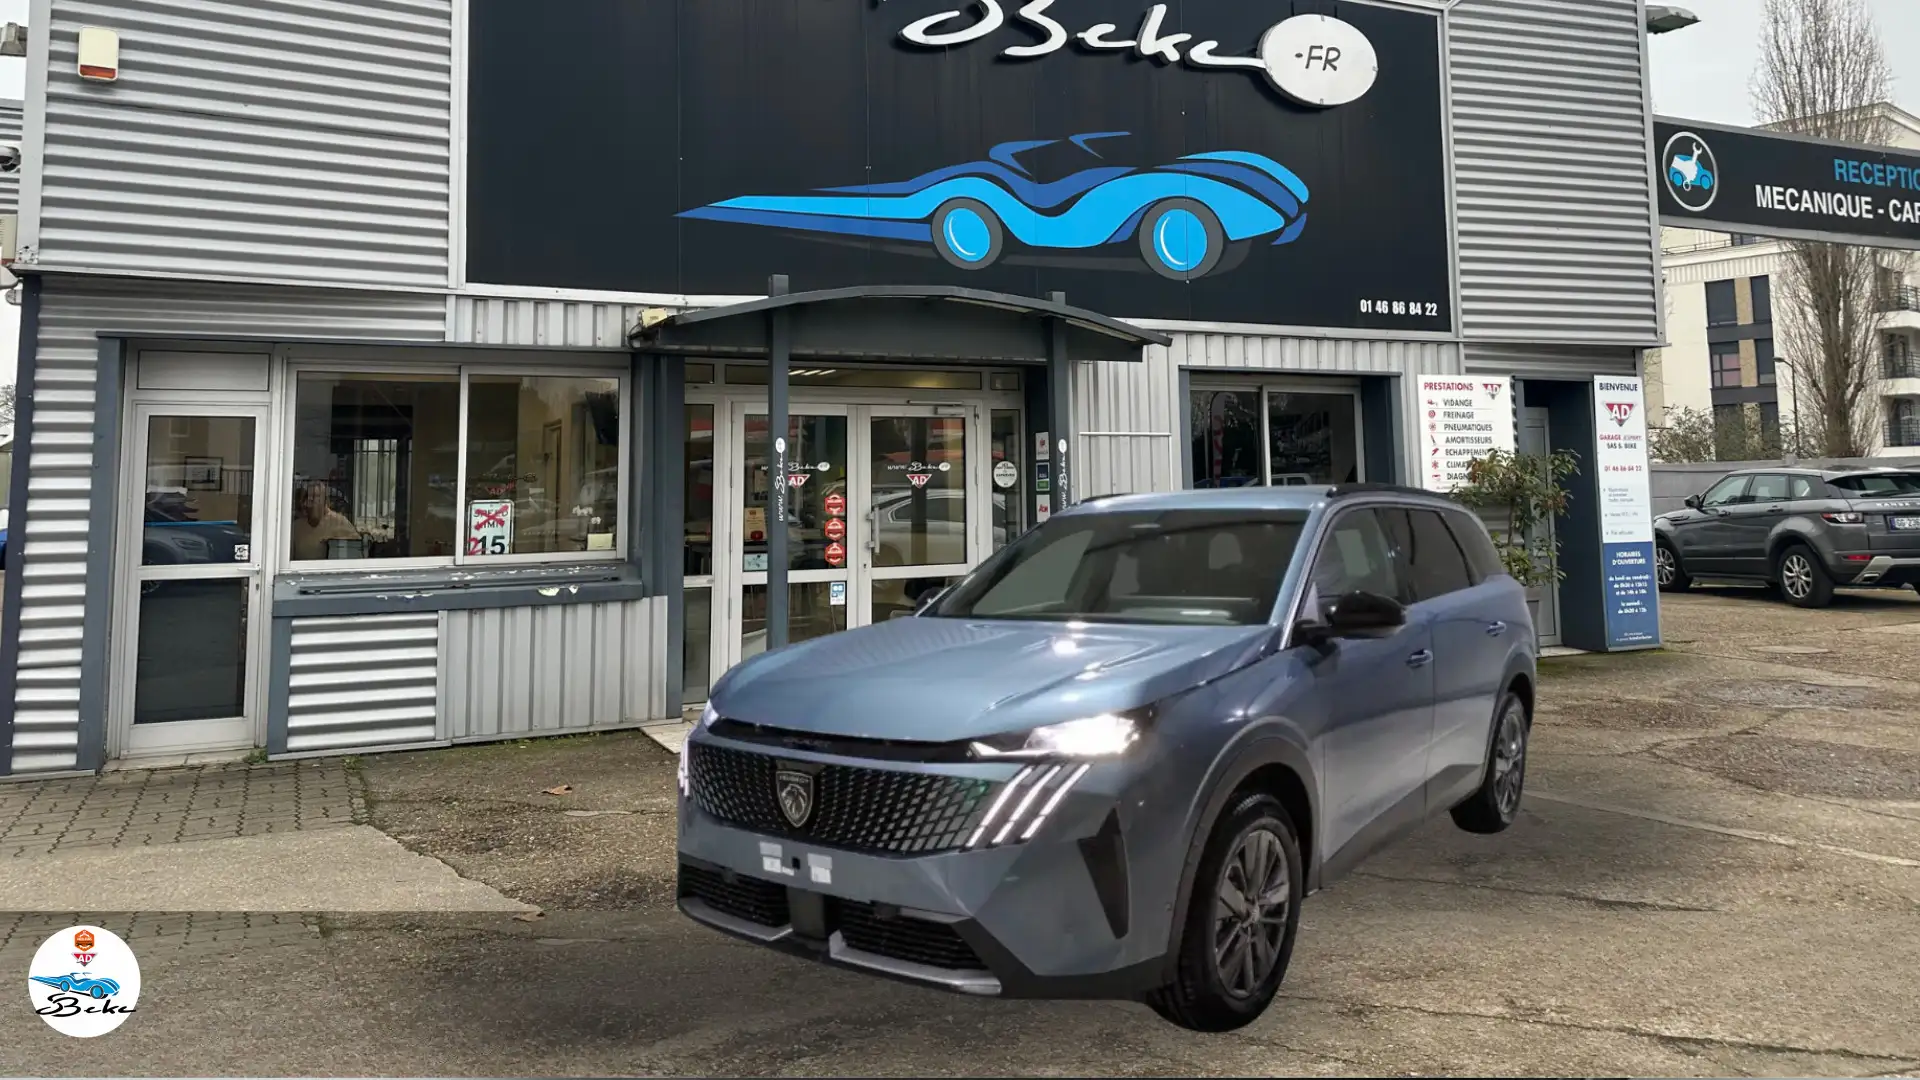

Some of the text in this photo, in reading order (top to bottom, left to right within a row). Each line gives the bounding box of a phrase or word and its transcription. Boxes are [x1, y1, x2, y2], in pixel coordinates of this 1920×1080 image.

[1755, 184, 1874, 219] MECANIQUE
[1360, 299, 1438, 317] 01 46 86 84 22
[1424, 382, 1474, 391] PRESTATIONS
[1599, 382, 1638, 391] BIENVENUE
[1443, 399, 1472, 407] VIDANGE
[1443, 411, 1474, 419] FREINAGE
[1611, 404, 1631, 419] AD
[1444, 423, 1493, 431] PNEUMATIQUES
[1445, 436, 1493, 444] AMORTISSEURS
[1445, 448, 1489, 456] ECHAPPEMEN
[788, 477, 805, 486] AD
[911, 476, 927, 485] AD
[473, 509, 509, 517] SPED
[479, 535, 505, 555] 15
